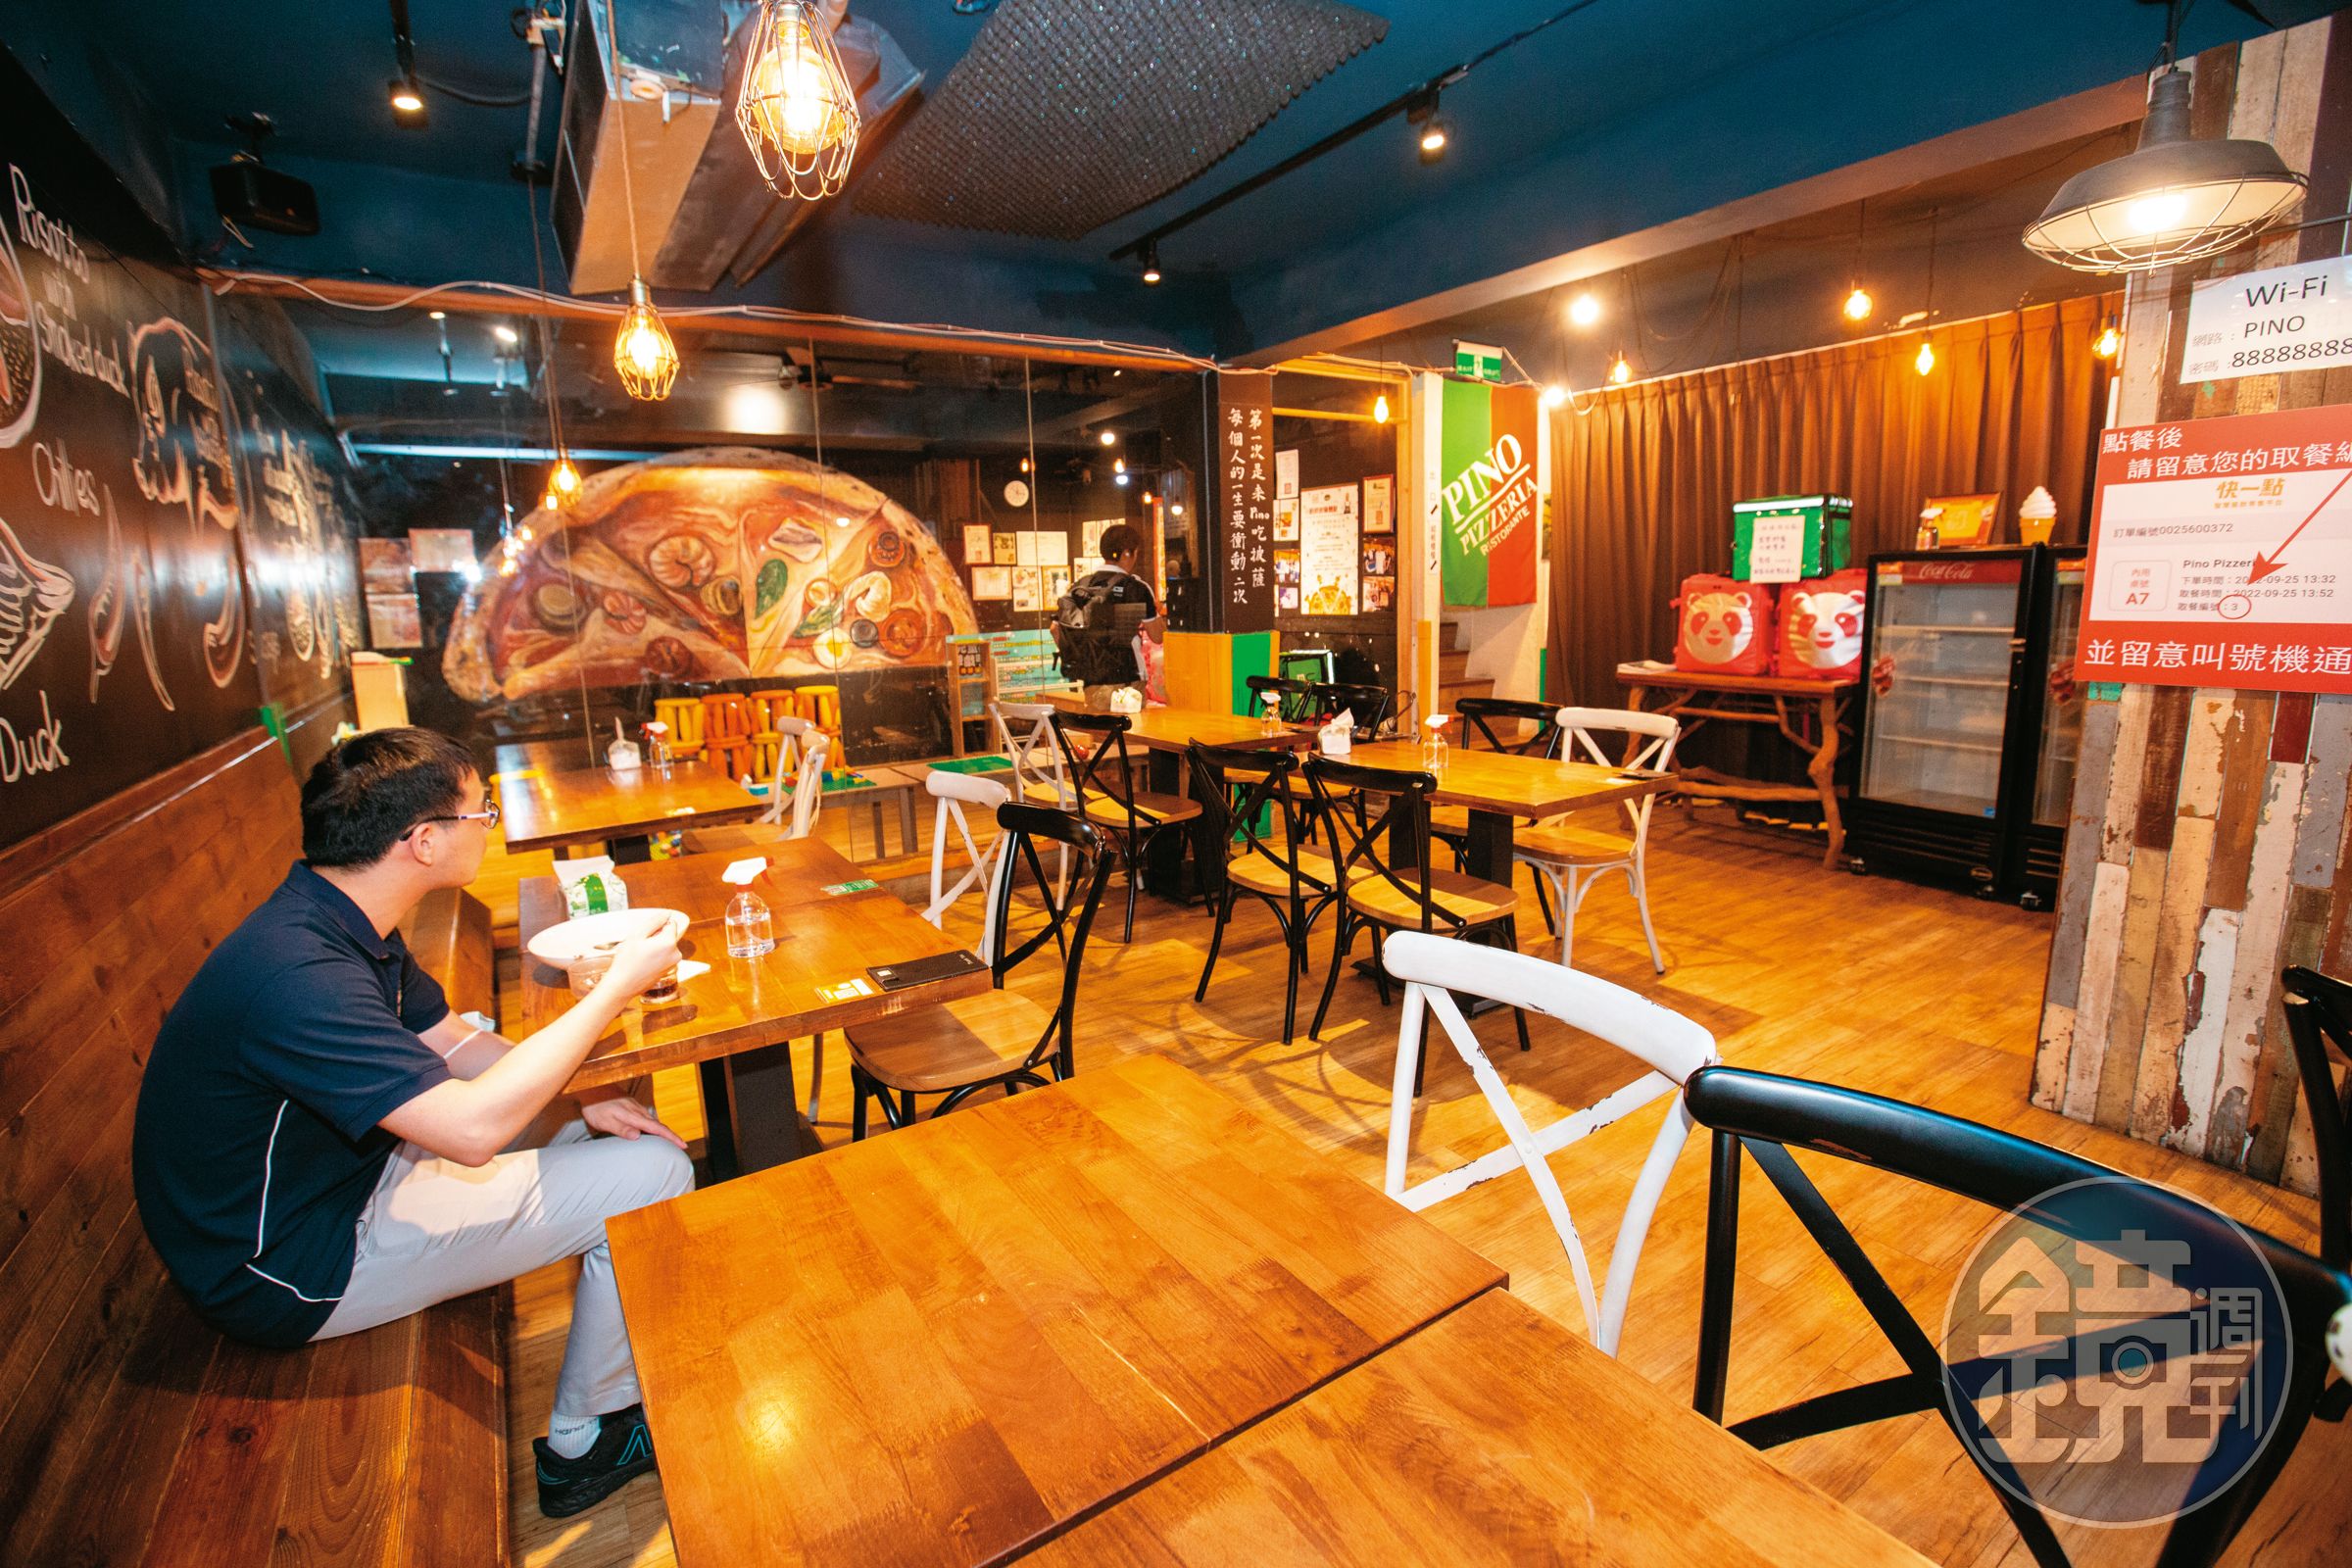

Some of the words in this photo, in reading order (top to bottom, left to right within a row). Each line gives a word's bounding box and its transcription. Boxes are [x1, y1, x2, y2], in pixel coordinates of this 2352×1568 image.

[2246, 275, 2328, 308] Wi-Fi
[2244, 315, 2305, 338] PINO
[2102, 426, 2182, 454] 點餐後
[1442, 433, 1522, 525] PINO
[2217, 477, 2285, 499] 快一點
[1458, 476, 1539, 557] PIZZERIA
[1480, 505, 1531, 557] RISTORANTE
[2182, 560, 2210, 568] Pino
[2303, 574, 2336, 584] 13:32
[2125, 592, 2150, 605] A7
[2301, 588, 2334, 598] 13:52
[2231, 603, 2238, 612] 3
[2084, 638, 2352, 675] 並留意叫號機通
[0, 689, 70, 783] Duck
